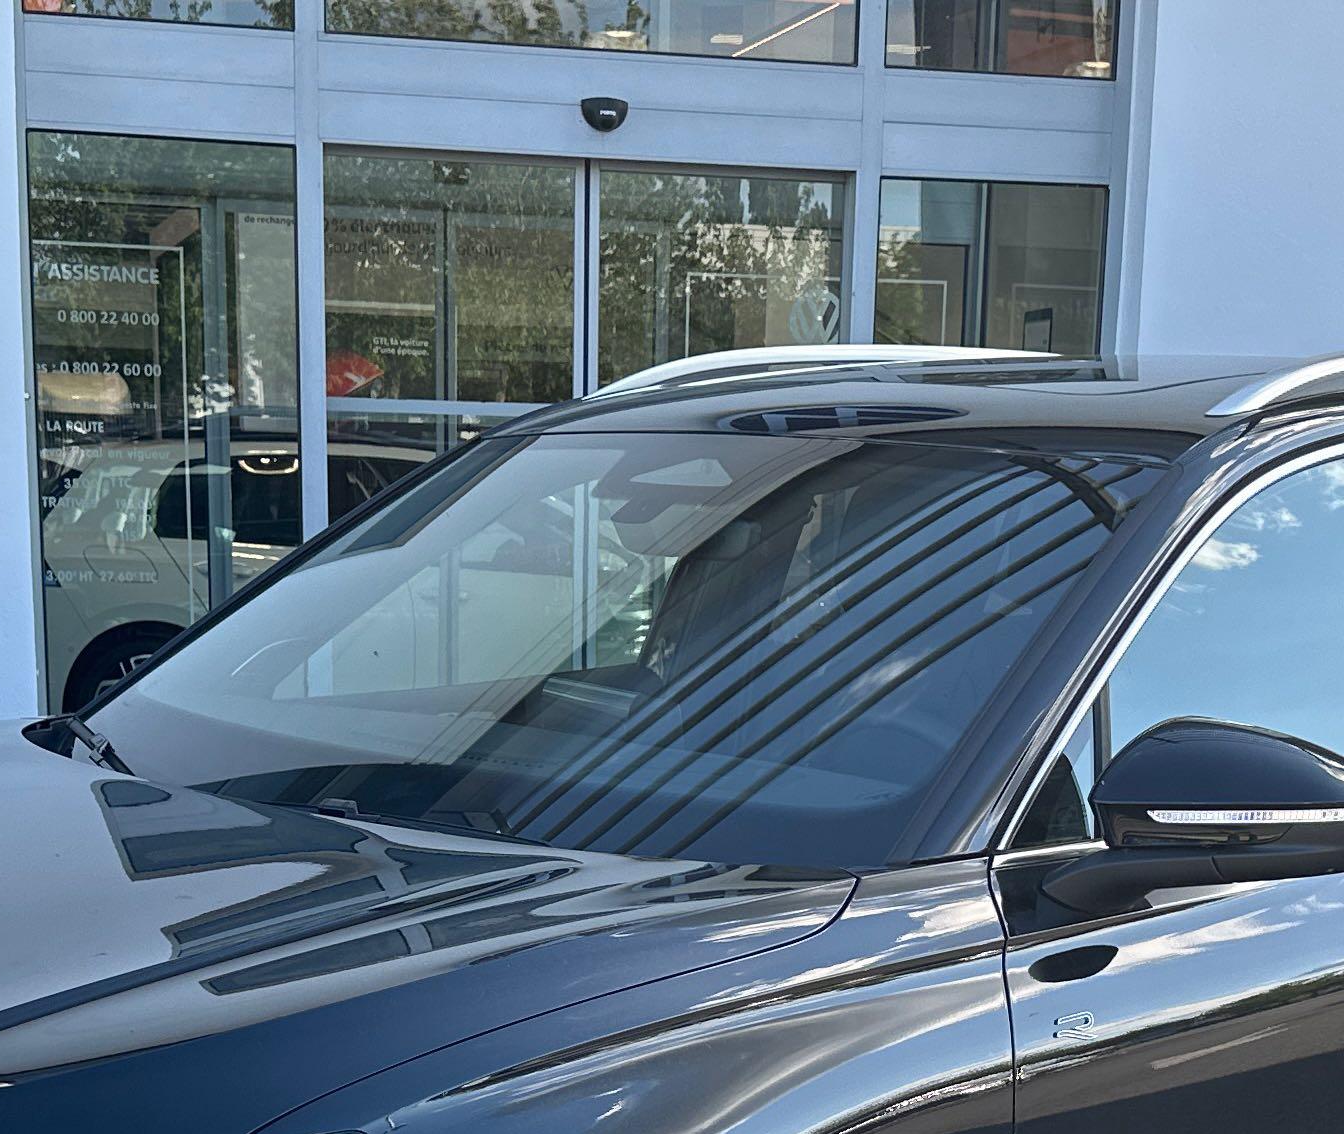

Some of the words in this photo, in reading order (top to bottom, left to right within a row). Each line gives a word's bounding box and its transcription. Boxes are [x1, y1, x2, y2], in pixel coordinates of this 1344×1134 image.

[48, 263, 160, 285] ASSISTANCE
[57, 309, 66, 323] 0
[70, 310, 96, 324] 800
[100, 311, 118, 324] 22
[121, 312, 138, 325] 40
[142, 313, 160, 326] 00
[72, 362, 99, 375] 800
[103, 362, 119, 376] 22
[123, 363, 140, 376] 60
[144, 364, 161, 377] 00
